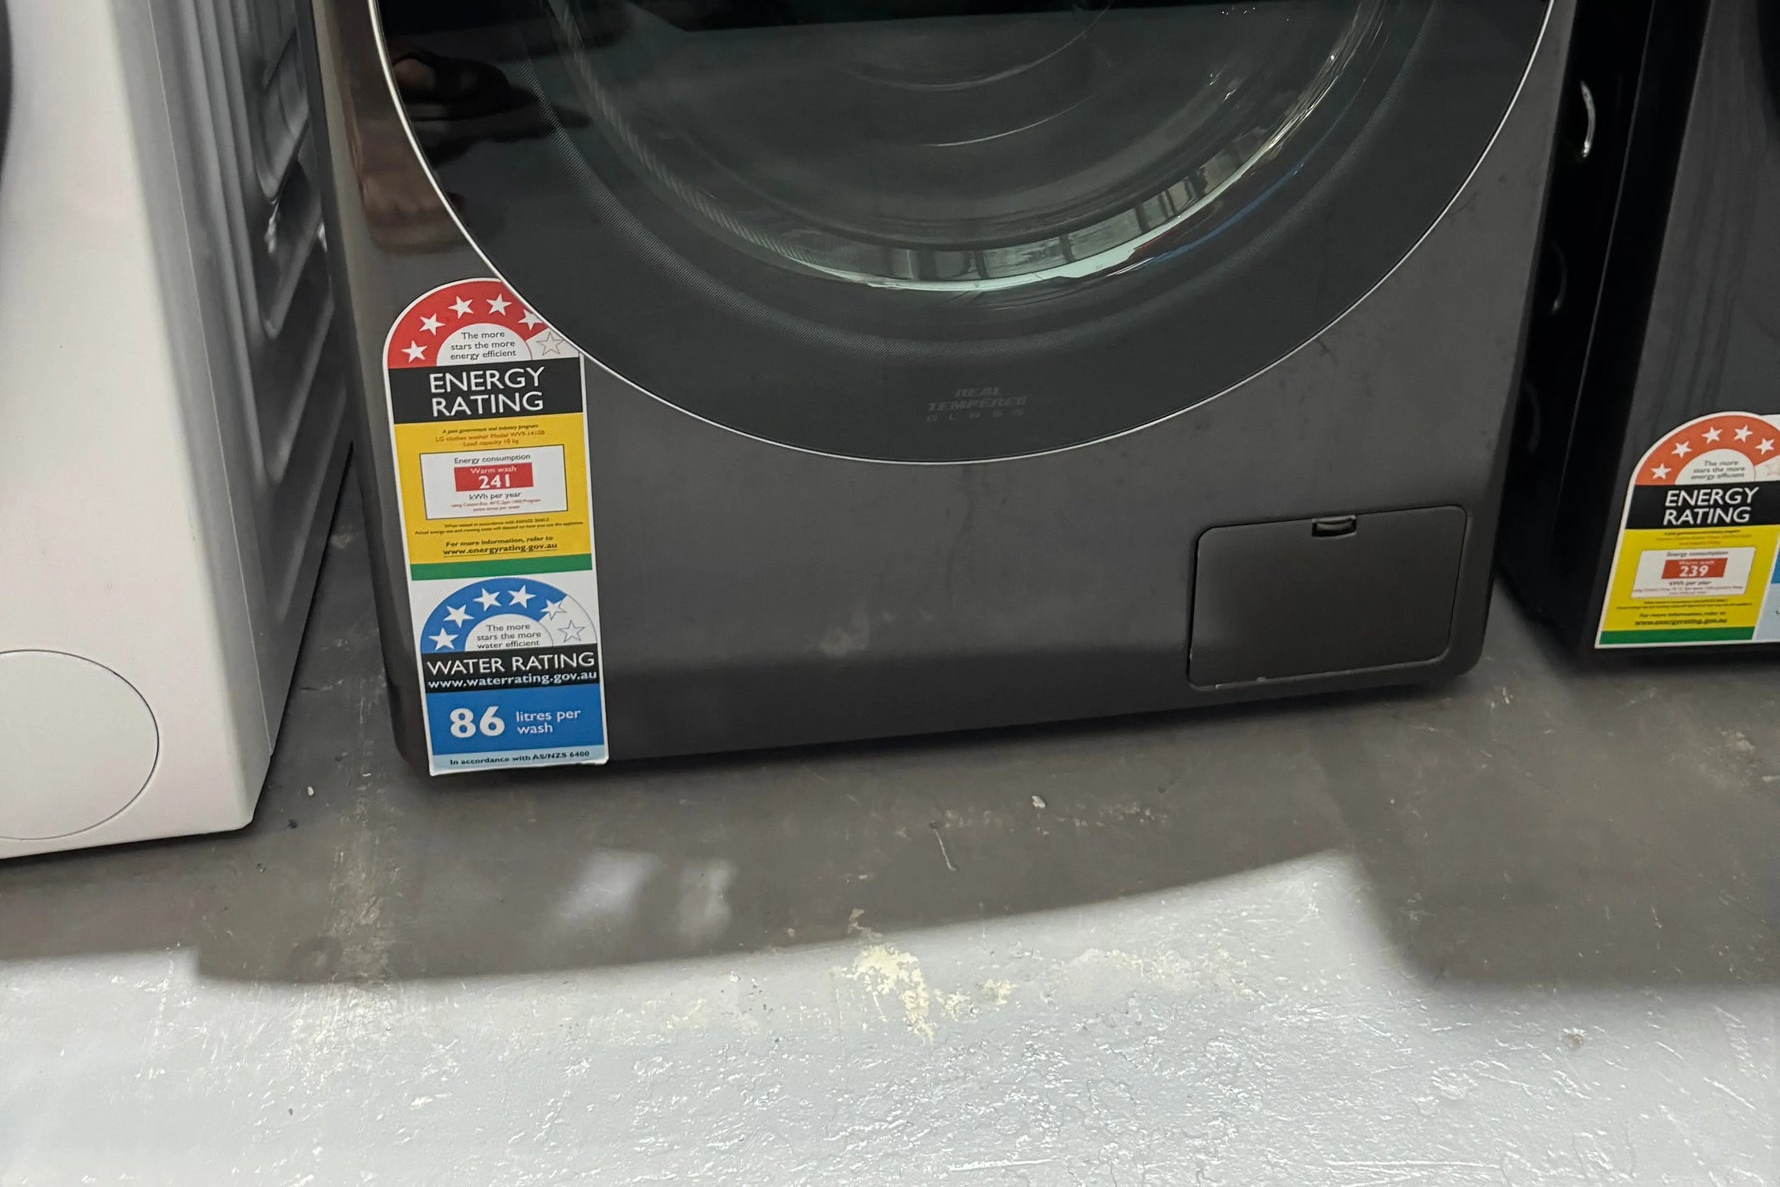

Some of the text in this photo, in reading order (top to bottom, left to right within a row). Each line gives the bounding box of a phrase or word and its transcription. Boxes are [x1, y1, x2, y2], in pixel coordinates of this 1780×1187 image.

[461, 331, 479, 340] The
[451, 341, 515, 351] stars the more
[450, 349, 517, 361] energy efficient
[429, 366, 545, 394] ENERGY
[432, 391, 544, 417] RATING
[454, 454, 531, 465] Energy consumption
[497, 465, 517, 473] wash
[478, 474, 511, 489] 241
[469, 492, 522, 501] kWh per year
[1665, 487, 1759, 507] ENERGY
[1663, 507, 1752, 526] RATING
[443, 543, 557, 555] www.energyrating.gov.au
[1679, 565, 1709, 577] 239
[500, 632, 515, 640] the
[505, 640, 540, 648] efficient
[427, 652, 595, 676] WATER RATING
[428, 671, 597, 689] www.waterrating.gov.au
[450, 706, 505, 738] 86
[516, 710, 581, 723] litres per
[517, 723, 553, 734] wash
[461, 757, 509, 765] accordance
[512, 754, 531, 762] with
